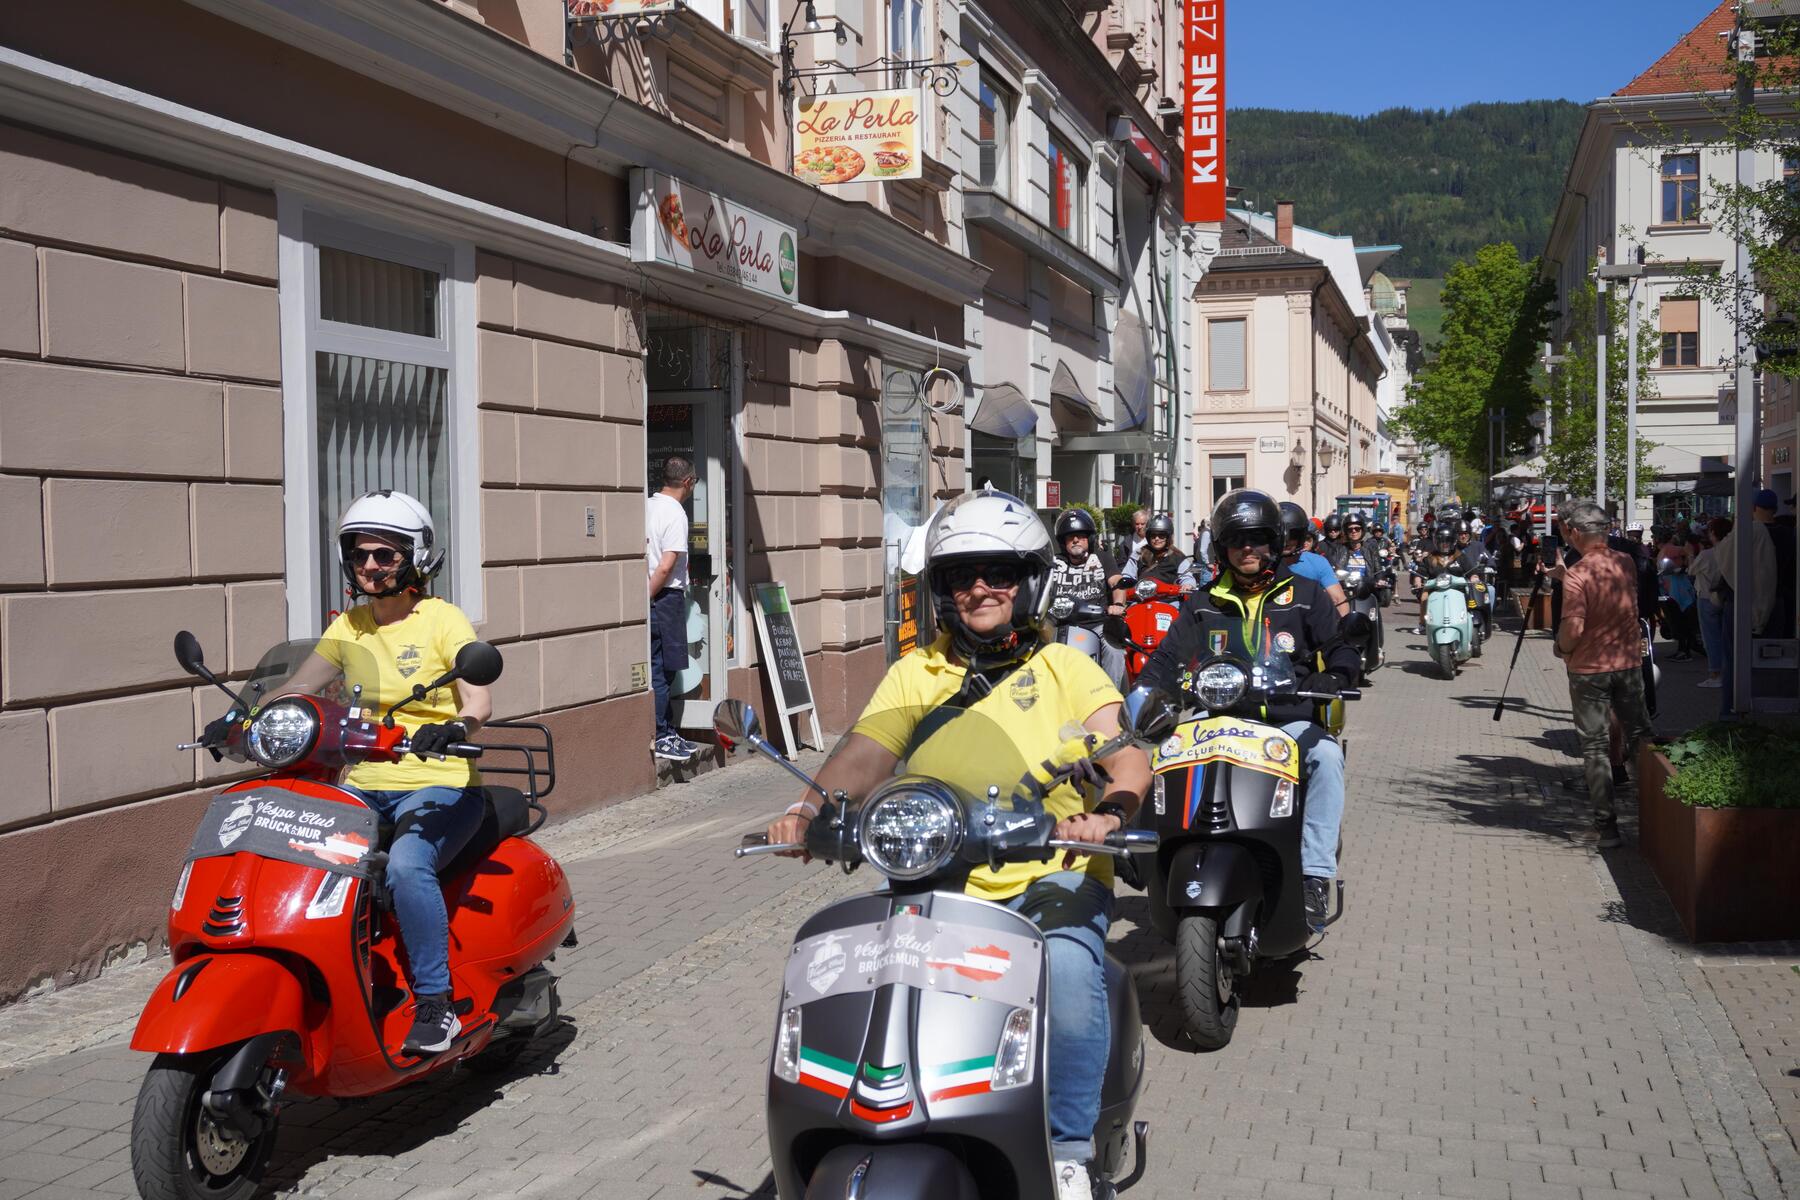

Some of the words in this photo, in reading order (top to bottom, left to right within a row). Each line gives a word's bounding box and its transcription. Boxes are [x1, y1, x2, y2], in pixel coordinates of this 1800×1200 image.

[797, 101, 840, 135] La
[844, 97, 919, 131] Perla
[1192, 53, 1218, 184] KLEINE
[814, 135, 846, 143] PIZZERIA
[854, 131, 902, 140] RESTAURANT
[690, 204, 724, 260] La
[726, 214, 774, 273] Perla
[1191, 721, 1260, 748] Vespa
[254, 816, 292, 834] BRUCK
[297, 826, 322, 840] MUR
[256, 801, 297, 819] Vespa
[298, 810, 336, 828] Club
[854, 939, 892, 960] Vespa
[892, 932, 934, 954] Club
[858, 953, 889, 974] BRUCK
[896, 952, 920, 969] MUR
